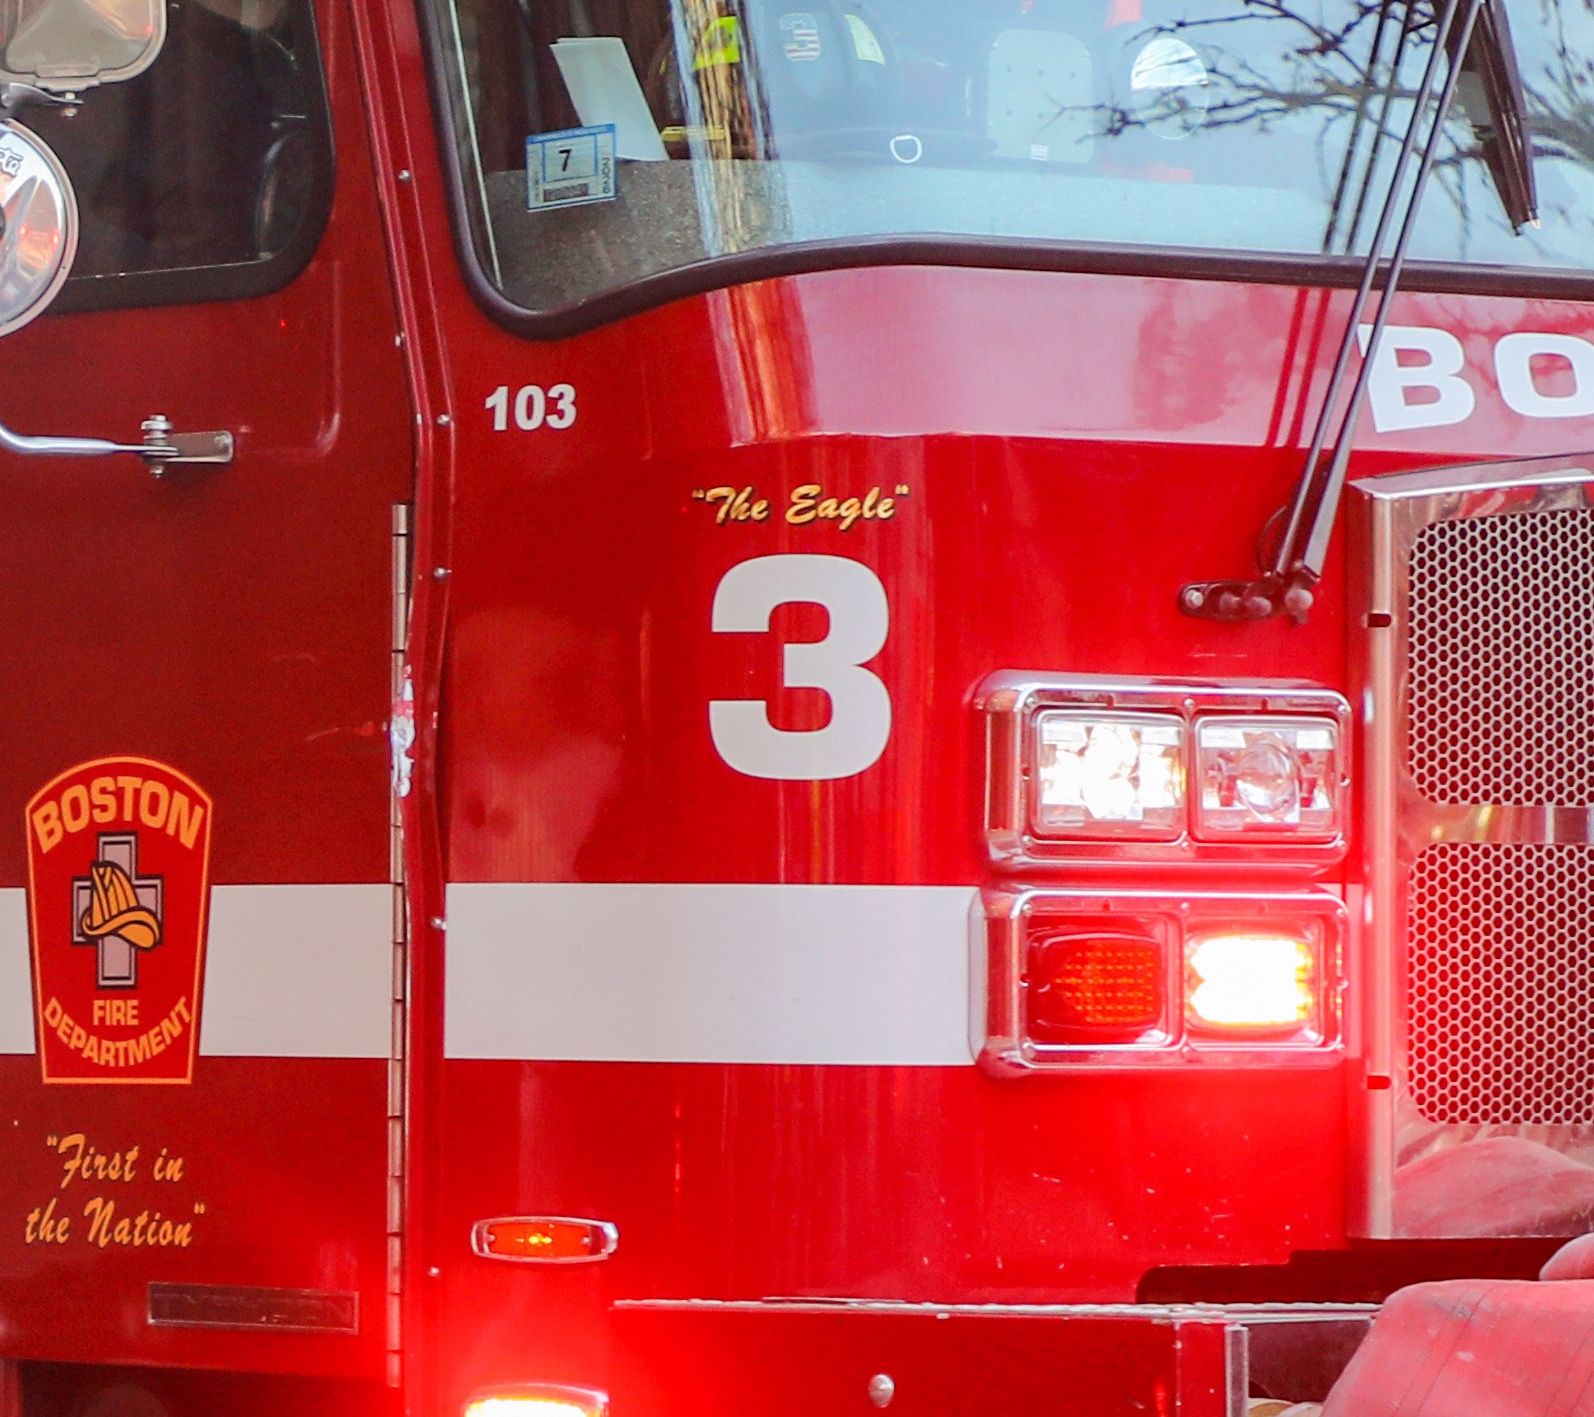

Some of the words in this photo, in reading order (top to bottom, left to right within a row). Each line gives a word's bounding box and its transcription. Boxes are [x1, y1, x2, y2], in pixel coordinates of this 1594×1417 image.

[558, 148, 572, 172] 7
[484, 383, 578, 432] 103
[708, 552, 893, 780] 3
[31, 775, 205, 855] BOSTON
[43, 995, 192, 1067] DEPARTMENT
[92, 998, 140, 1027] FIRE
[152, 1145, 185, 1182] in
[24, 1196, 70, 1248] the
